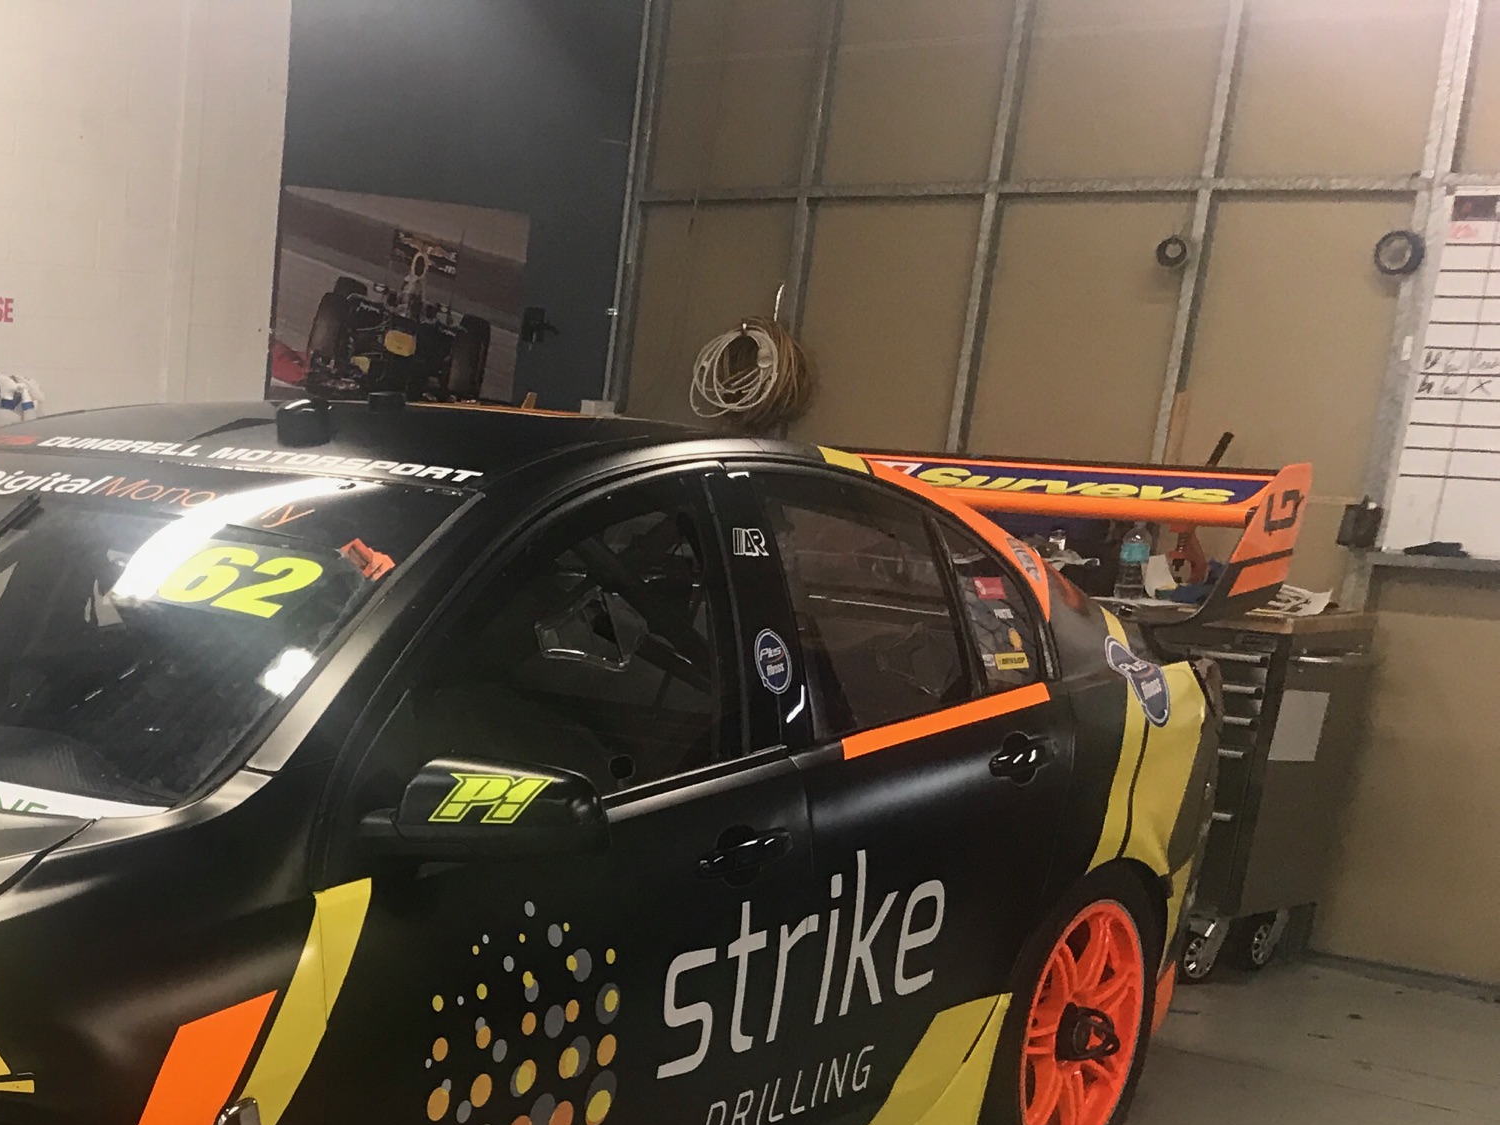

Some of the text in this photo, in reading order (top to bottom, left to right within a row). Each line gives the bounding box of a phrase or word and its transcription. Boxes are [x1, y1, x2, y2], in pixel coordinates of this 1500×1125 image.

[38, 436, 484, 482] DUMBRELL MOTORSPORT
[916, 466, 1235, 503] Surveys
[158, 546, 324, 619] 62
[428, 773, 555, 824] P1
[656, 849, 946, 1079] strike
